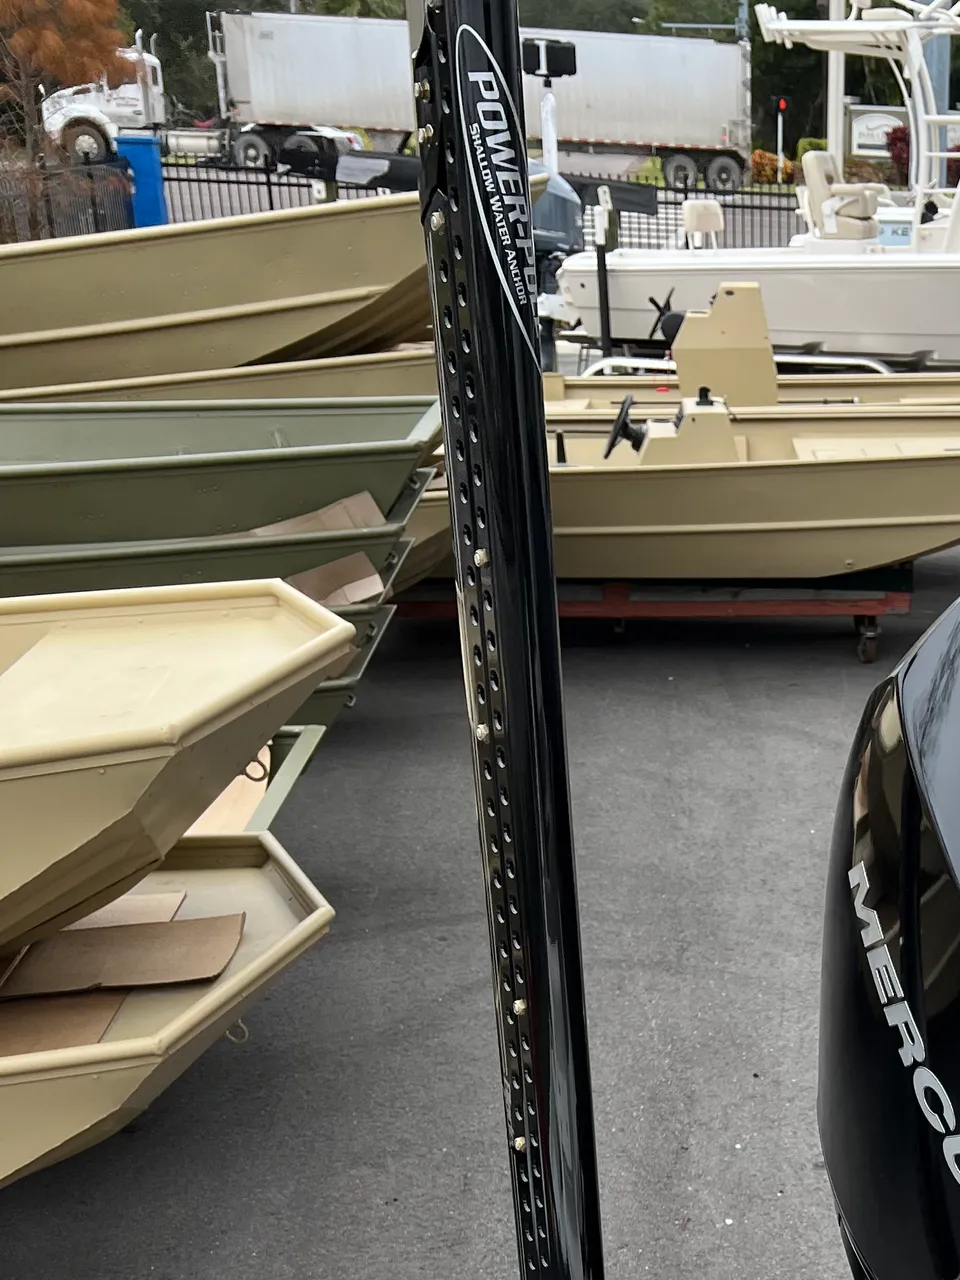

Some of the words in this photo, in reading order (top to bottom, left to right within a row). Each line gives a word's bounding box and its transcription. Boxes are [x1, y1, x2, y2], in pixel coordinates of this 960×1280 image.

[469, 123, 496, 192] SHALLOW
[490, 194, 511, 246] WATER
[505, 249, 528, 305] ANCHOR
